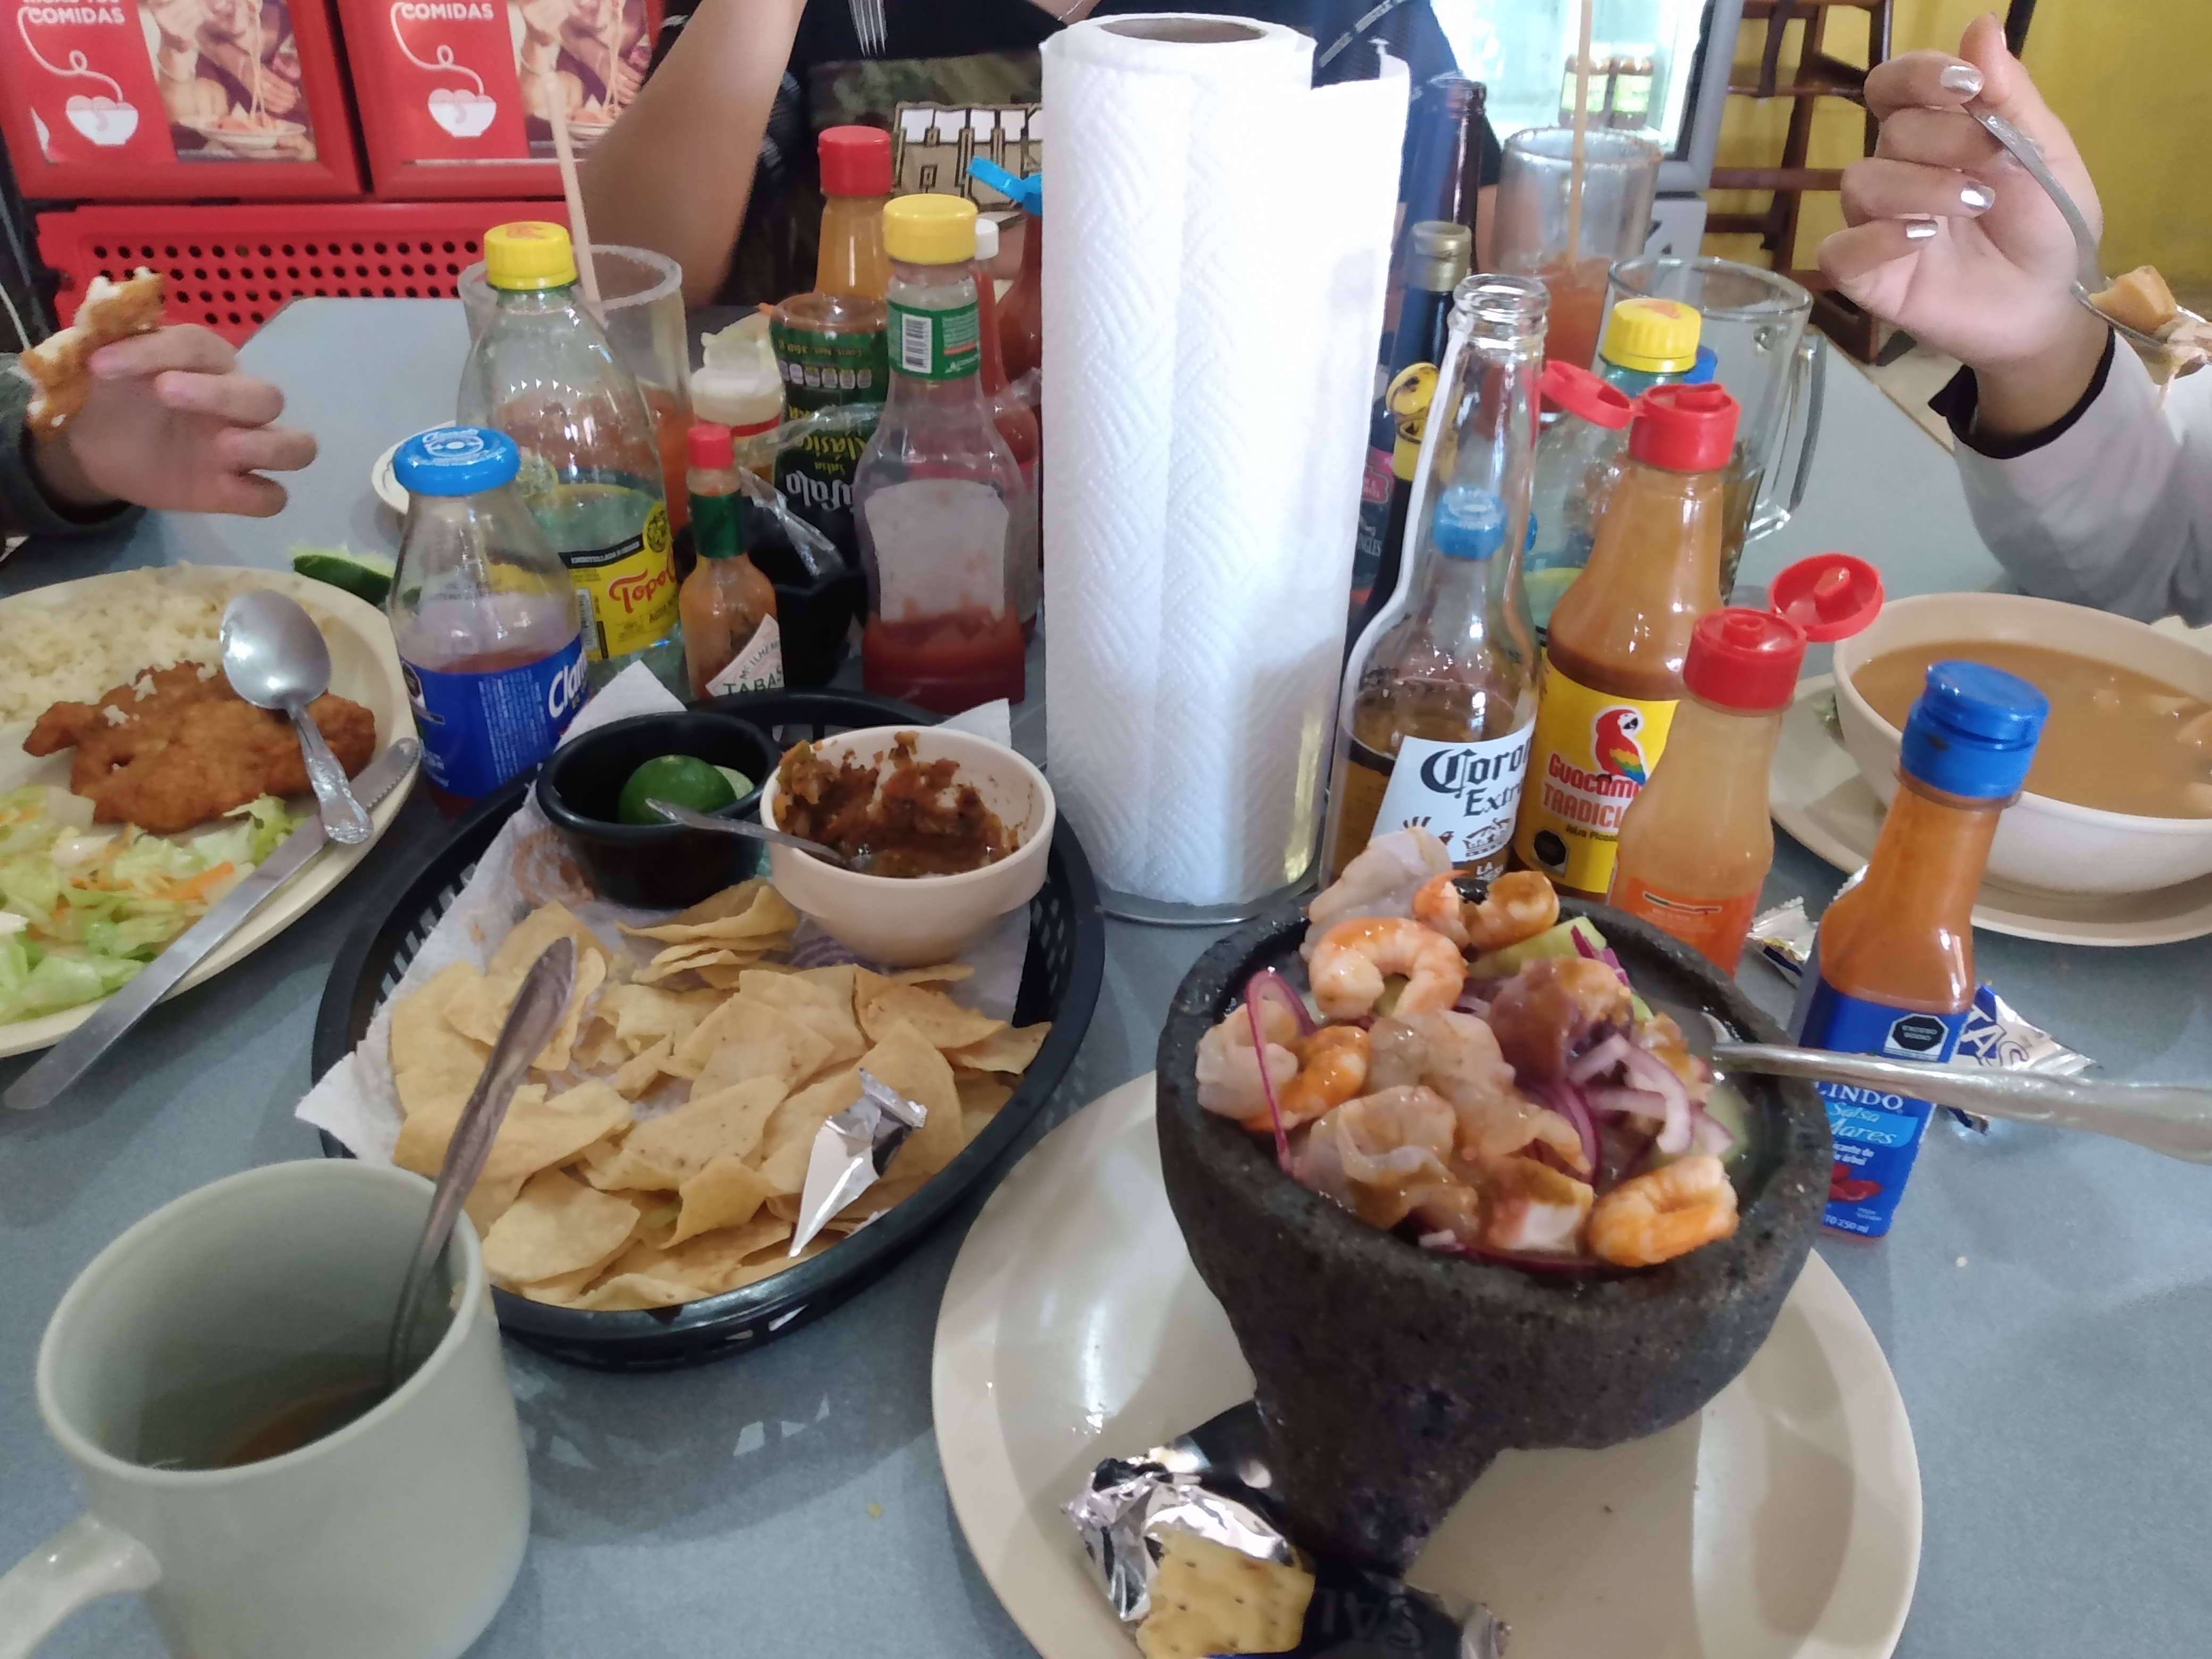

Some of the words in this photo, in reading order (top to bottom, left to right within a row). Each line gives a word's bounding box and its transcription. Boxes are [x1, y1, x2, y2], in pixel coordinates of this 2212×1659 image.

[28, 7, 125, 24] COMIDAS
[401, 3, 494, 20] COMIDAS
[1830, 1102, 1881, 1123] Salsa
